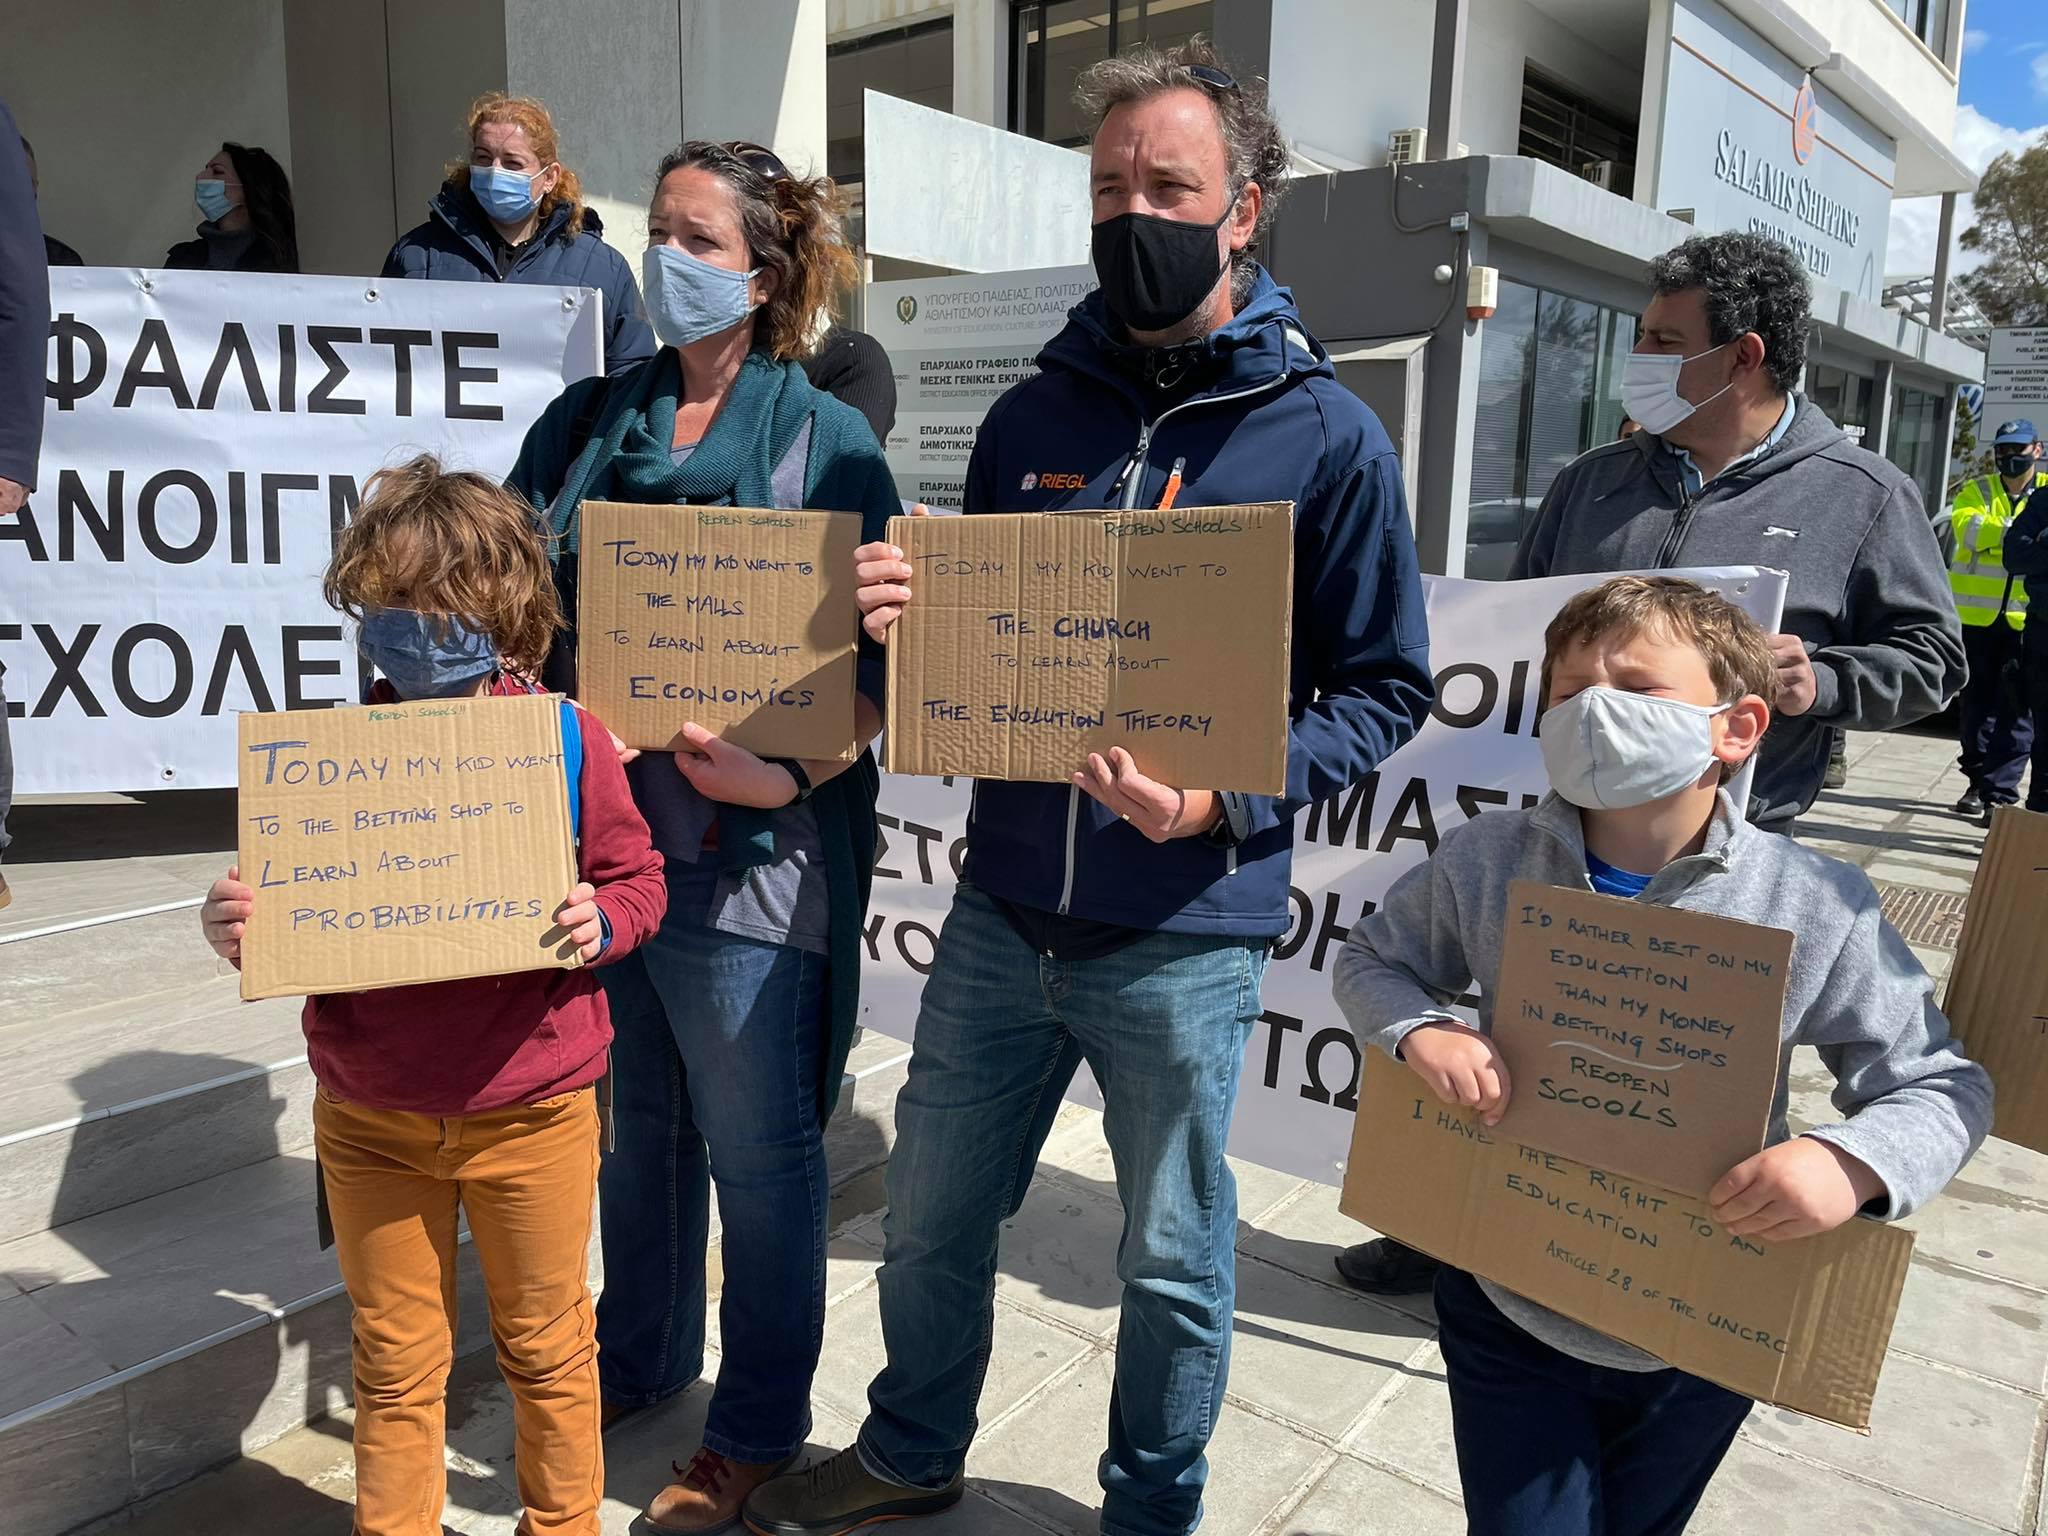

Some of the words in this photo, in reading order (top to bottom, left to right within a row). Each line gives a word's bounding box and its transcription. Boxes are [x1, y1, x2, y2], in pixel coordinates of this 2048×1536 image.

[1715, 128, 1796, 214] SALAMIS
[1797, 176, 1860, 248] SHIPPING
[925, 291, 980, 306] ΥΠΟΥΡΓΕΙΟ
[925, 306, 990, 321] ΑΘΛΗΤΙΣΜΟΥ
[994, 305, 1010, 317] ΚΑΙ
[920, 360, 973, 371] ΕΠΑΡΧΙΑΚΟ
[976, 358, 1019, 369] ΓΡΑΦΕΙΟ
[920, 376, 952, 385] ΜΕΣΗΣ
[955, 374, 995, 385] ΓΕΝΙΚΗΣ
[920, 425, 973, 435] ΕΠΑΡΧΙΑΚΟ
[920, 440, 974, 450] ΔΗΜΟΤΙΚΗΣ
[1040, 473, 1088, 489] RIEGL
[919, 496, 935, 506] ΚΑΙ
[1103, 519, 1166, 538] REOPEN
[603, 540, 679, 577] TODAY
[713, 554, 738, 571] KID
[744, 558, 791, 574] WENT
[794, 562, 814, 576] TO
[915, 552, 1004, 578] TODAY
[1036, 561, 1062, 578] MY
[1082, 561, 1113, 579] KID
[1127, 563, 1187, 579] WENT
[1199, 563, 1228, 578] TO
[637, 592, 677, 609] THE
[686, 595, 745, 617] MALLS
[605, 630, 630, 645] TO
[648, 631, 704, 654] LEARN
[723, 639, 801, 658] ABOUT
[987, 613, 1036, 636] THE
[1053, 616, 1153, 642] CHURCH
[0, 623, 374, 718] ΧΟΛΕ
[992, 653, 1018, 669] TO
[1031, 652, 1091, 669] LEARN
[1104, 653, 1171, 672] ABOUT
[629, 676, 816, 709] ECONOMICS
[922, 700, 971, 722] THE
[990, 704, 1105, 730] EVOLUTION
[1117, 708, 1215, 737] THEORY
[248, 741, 388, 786] TODAY
[407, 757, 442, 779] MY
[455, 755, 496, 773] KID
[504, 753, 565, 770] WENT
[249, 815, 281, 836] TO
[298, 818, 339, 836] THE
[353, 808, 437, 832] BETTING
[450, 802, 493, 819] SHOP
[503, 801, 524, 815] TO
[259, 860, 358, 889] LEARN
[376, 850, 461, 873] ABOUT
[289, 896, 543, 933] PROBABILITIES
[1521, 904, 1552, 928] I'D
[1568, 918, 1634, 949] RATHER
[1648, 937, 1701, 959] BET
[1708, 953, 1735, 969] ON
[1743, 959, 1772, 977] MY
[1550, 949, 1688, 992] EDUCATION
[1555, 981, 1607, 1007] THAN
[1620, 997, 1649, 1018] MY
[1659, 1008, 1735, 1040] MONEY
[1521, 1000, 1543, 1020] IN
[1551, 1012, 1644, 1058] BETTING
[1656, 1037, 1728, 1068] SHOPS
[1570, 1056, 1671, 1098] REOPEN
[1537, 1077, 1678, 1128] SCOOLS
[1411, 1099, 1425, 1120] I
[1437, 1111, 1495, 1145] HAVE
[1513, 1142, 1568, 1175] THE
[1589, 1169, 1668, 1213] RIGHT
[1682, 1211, 1713, 1237] TO
[1730, 1235, 1765, 1257] AN
[1507, 1173, 1658, 1248] EDUCATION
[1546, 1239, 1600, 1276] ARTICLE
[1606, 1268, 1632, 1292] 28
[1642, 1288, 1661, 1300] OF
[1668, 1296, 1697, 1320] THE
[1708, 1312, 1789, 1354] UNCRC
